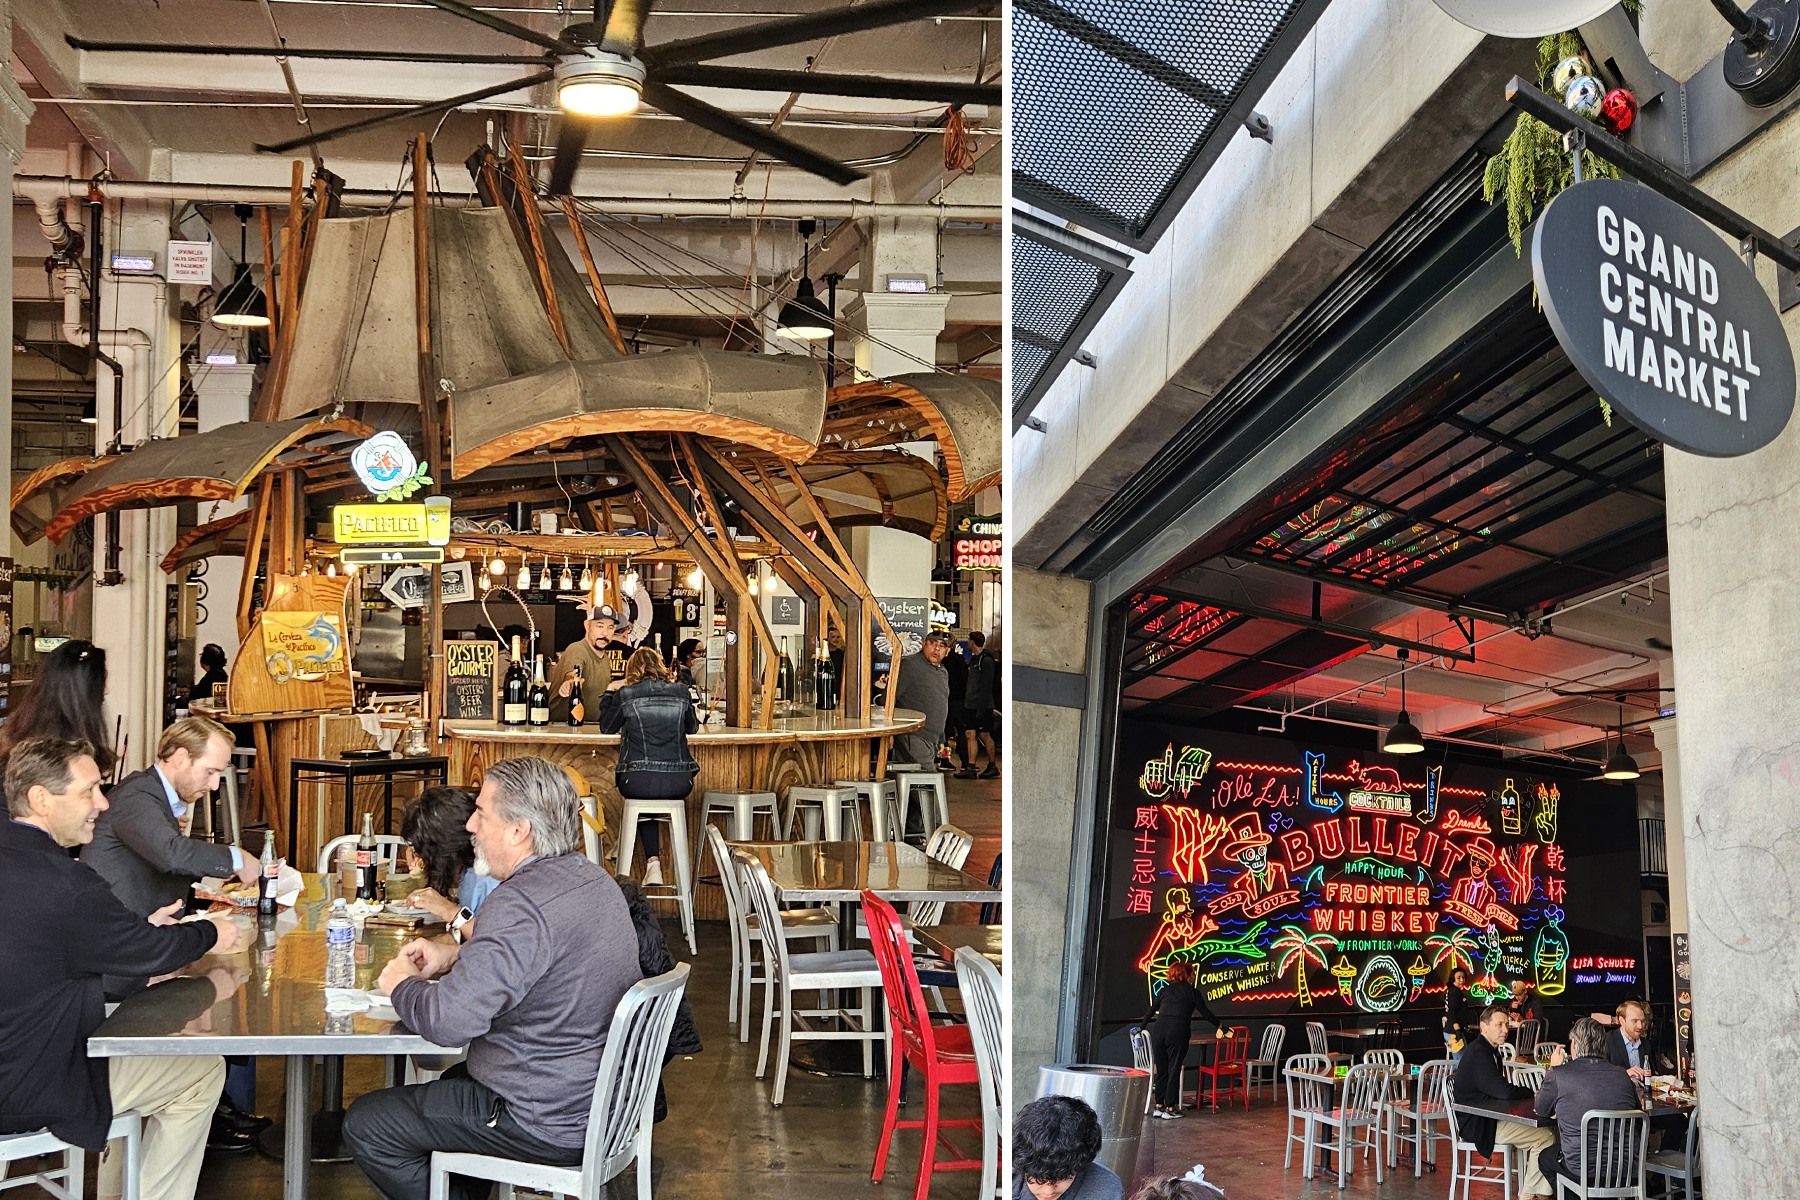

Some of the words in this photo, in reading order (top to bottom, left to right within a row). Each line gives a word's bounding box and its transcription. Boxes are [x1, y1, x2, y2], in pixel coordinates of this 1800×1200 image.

[1597, 205, 1719, 304] GRAND
[1600, 262, 1760, 376] CENTRAL
[1603, 318, 1750, 421] MARKET
[340, 513, 419, 535] PACIFICO
[957, 540, 1002, 553] CHOP
[889, 618, 924, 628] ourmet
[447, 644, 494, 662] OYSTER
[447, 660, 494, 678] GOURMET
[456, 684, 485, 695] OYSTERS
[460, 694, 482, 707] BEER
[458, 705, 482, 718] WINE
[1314, 796, 1339, 807] HOURS
[1349, 792, 1412, 812] COCKTAILS
[1429, 771, 1437, 818] DRINKS
[1281, 816, 1466, 879] BULLEIT
[1126, 805, 1159, 914] 威士忌酒
[1344, 862, 1376, 875] HAPPY
[1377, 867, 1404, 880] HOUR
[1547, 842, 1568, 904] 乾杯
[1220, 893, 1243, 909] OLD
[1325, 882, 1430, 906] FRONTIER
[1254, 894, 1288, 915] SOUL
[1455, 902, 1484, 925] FRESH
[1313, 908, 1440, 933] WHISKEY
[1499, 935, 1523, 944] WATCH
[1508, 945, 1523, 953] YOUR
[1502, 955, 1530, 969] PICKLE
[1506, 963, 1524, 975] BACK
[1573, 956, 1593, 969] LISA
[1200, 969, 1244, 986] CONSERVE
[1246, 960, 1276, 975] WATER
[1207, 983, 1234, 1002] DRINK
[1235, 973, 1276, 993] WHISKEY
